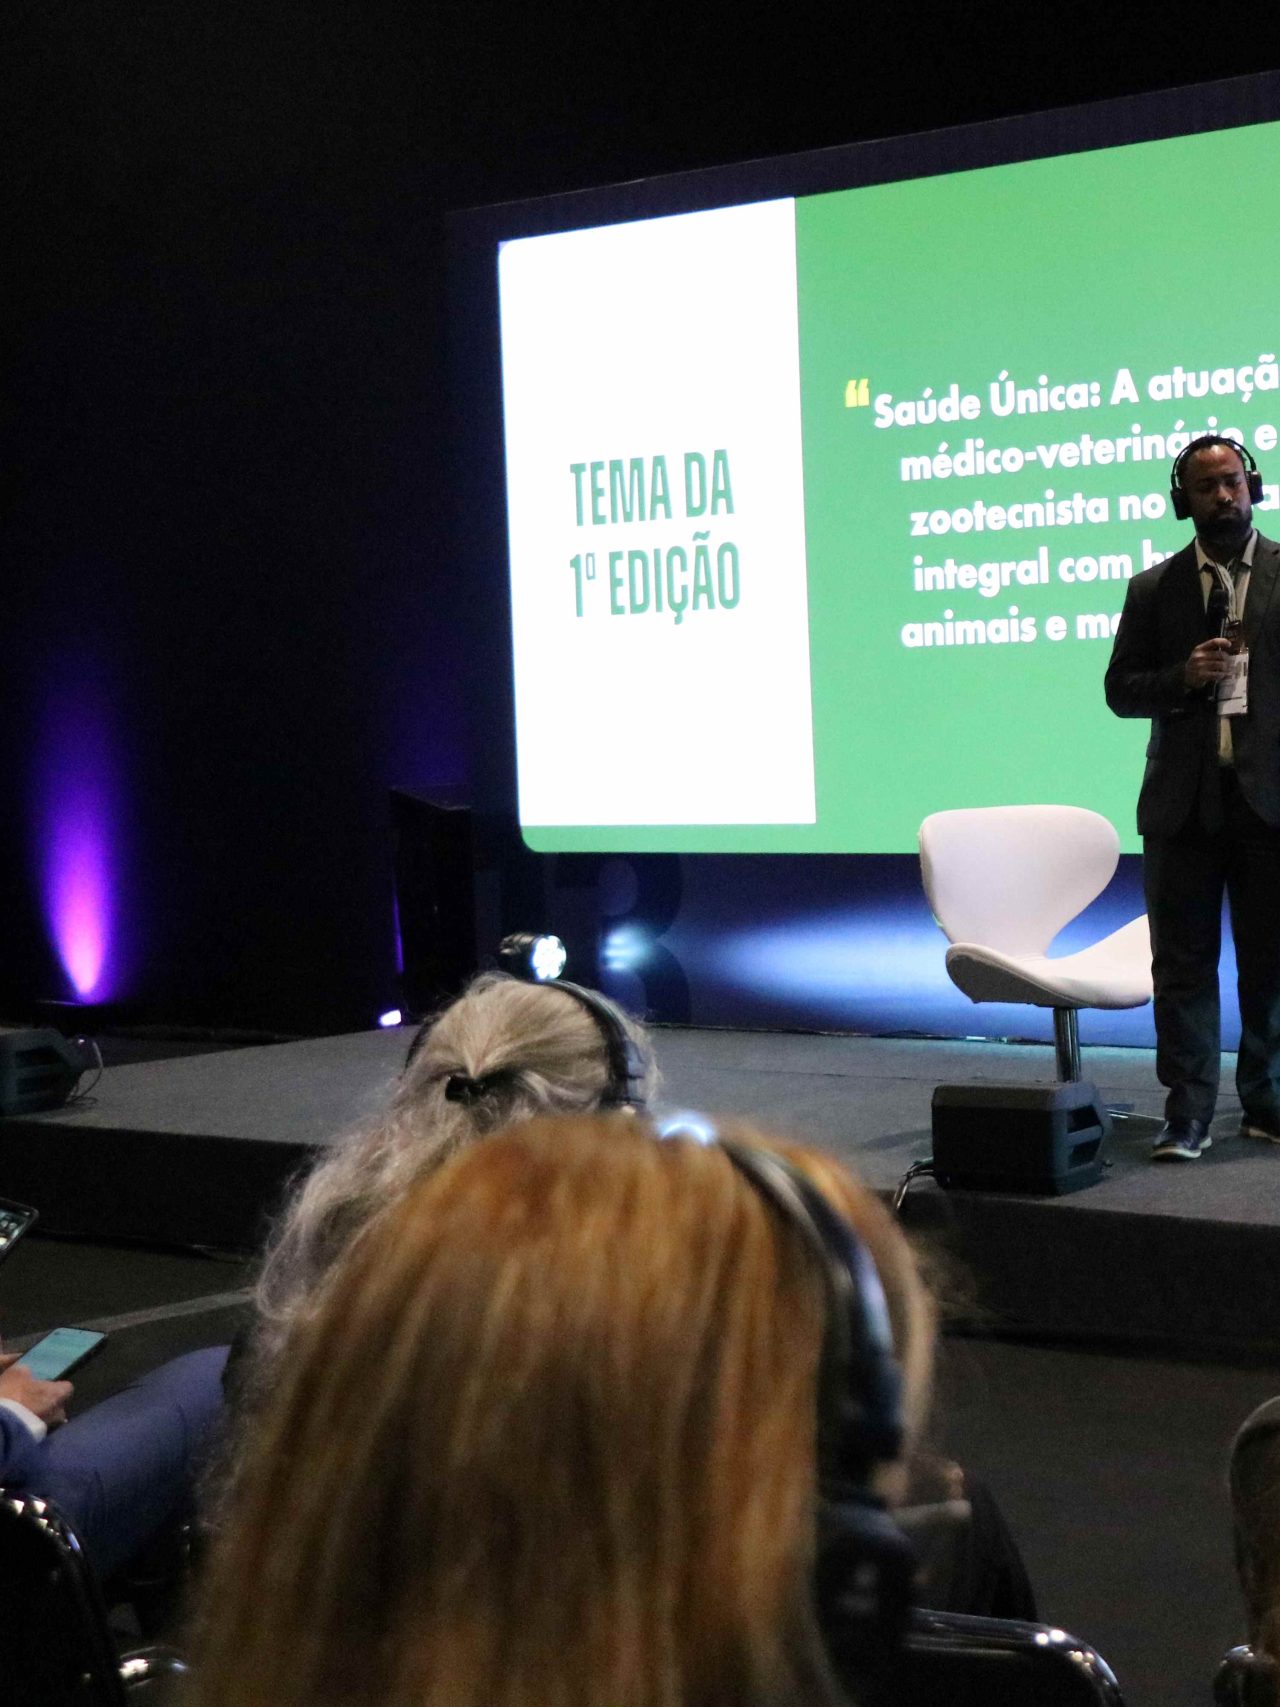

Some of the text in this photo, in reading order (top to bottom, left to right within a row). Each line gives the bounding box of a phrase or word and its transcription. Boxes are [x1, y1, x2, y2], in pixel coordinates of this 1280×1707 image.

[990, 369, 1101, 417] Única:
[1110, 368, 1140, 405] A
[1254, 424, 1278, 451] e
[569, 448, 735, 527] TEMA DA
[910, 488, 1167, 537] zootecnista no
[608, 530, 741, 626] EDIÇÃO
[913, 545, 1050, 598] integral
[1058, 553, 1133, 583] com
[900, 605, 1037, 648] animais
[1045, 615, 1068, 641] e
